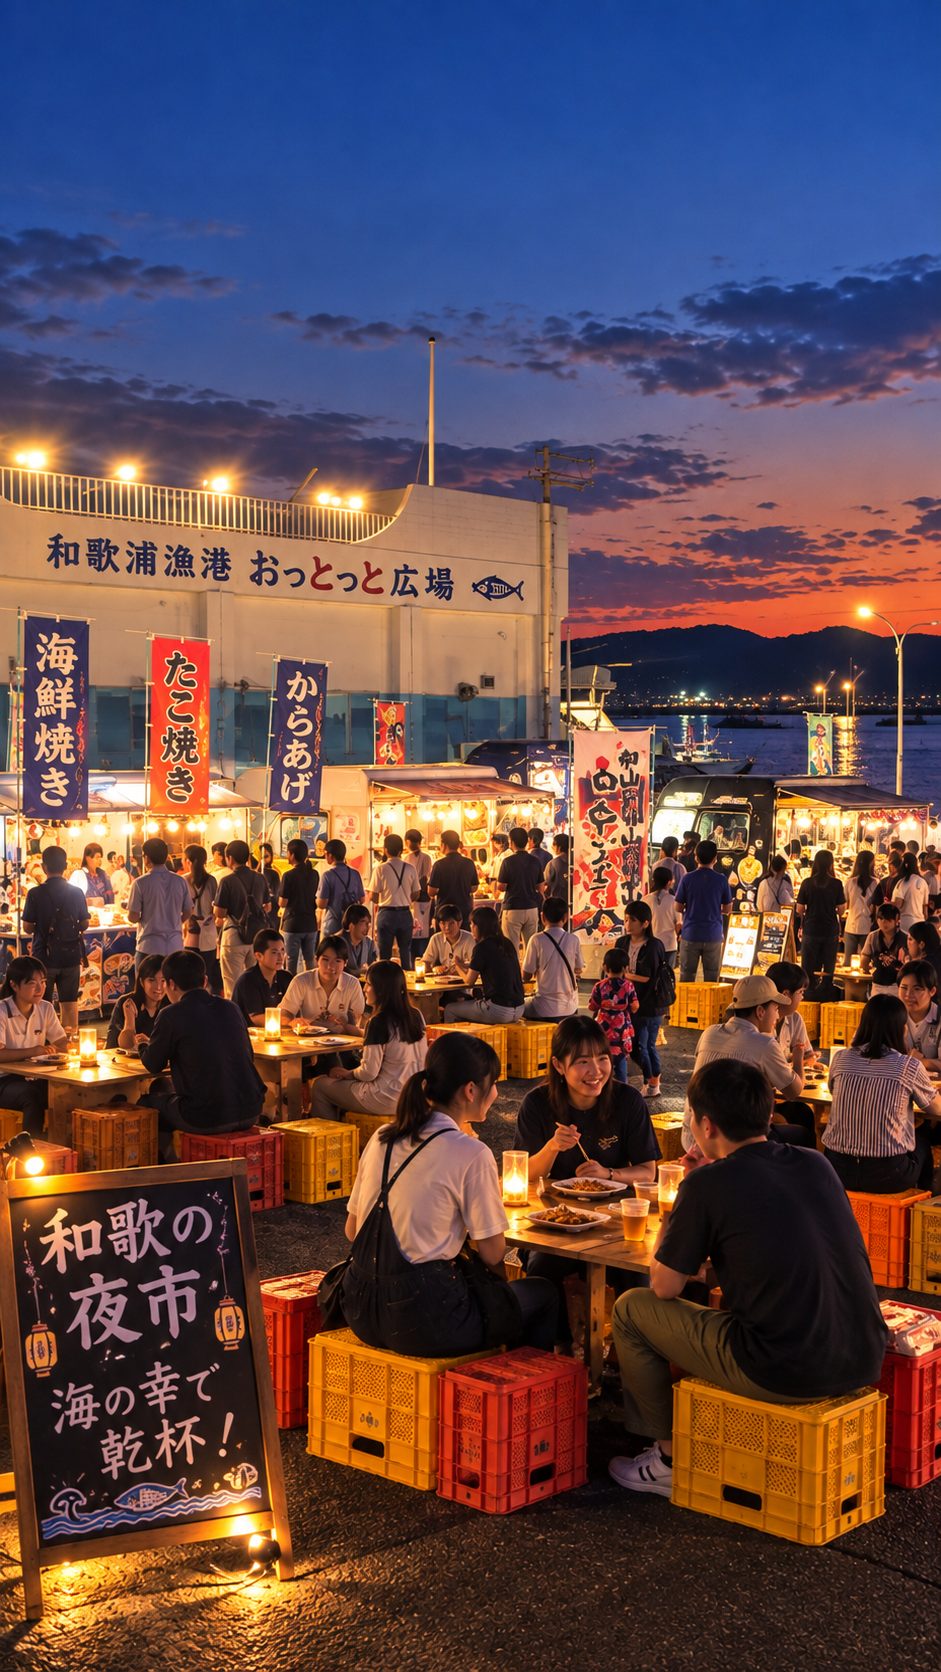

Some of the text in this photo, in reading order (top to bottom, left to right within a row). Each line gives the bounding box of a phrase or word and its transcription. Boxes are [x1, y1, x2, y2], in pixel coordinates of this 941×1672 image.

[46, 533, 455, 601] 和歌浦漁港 おっとっと広場
[34, 632, 79, 807] 海鮮焼き
[161, 650, 200, 804] たこ焼き
[280, 670, 318, 804] からあげ
[39, 1198, 213, 1274] 和歌の
[66, 1264, 201, 1351] 夜市
[51, 1360, 221, 1435] 海の幸で
